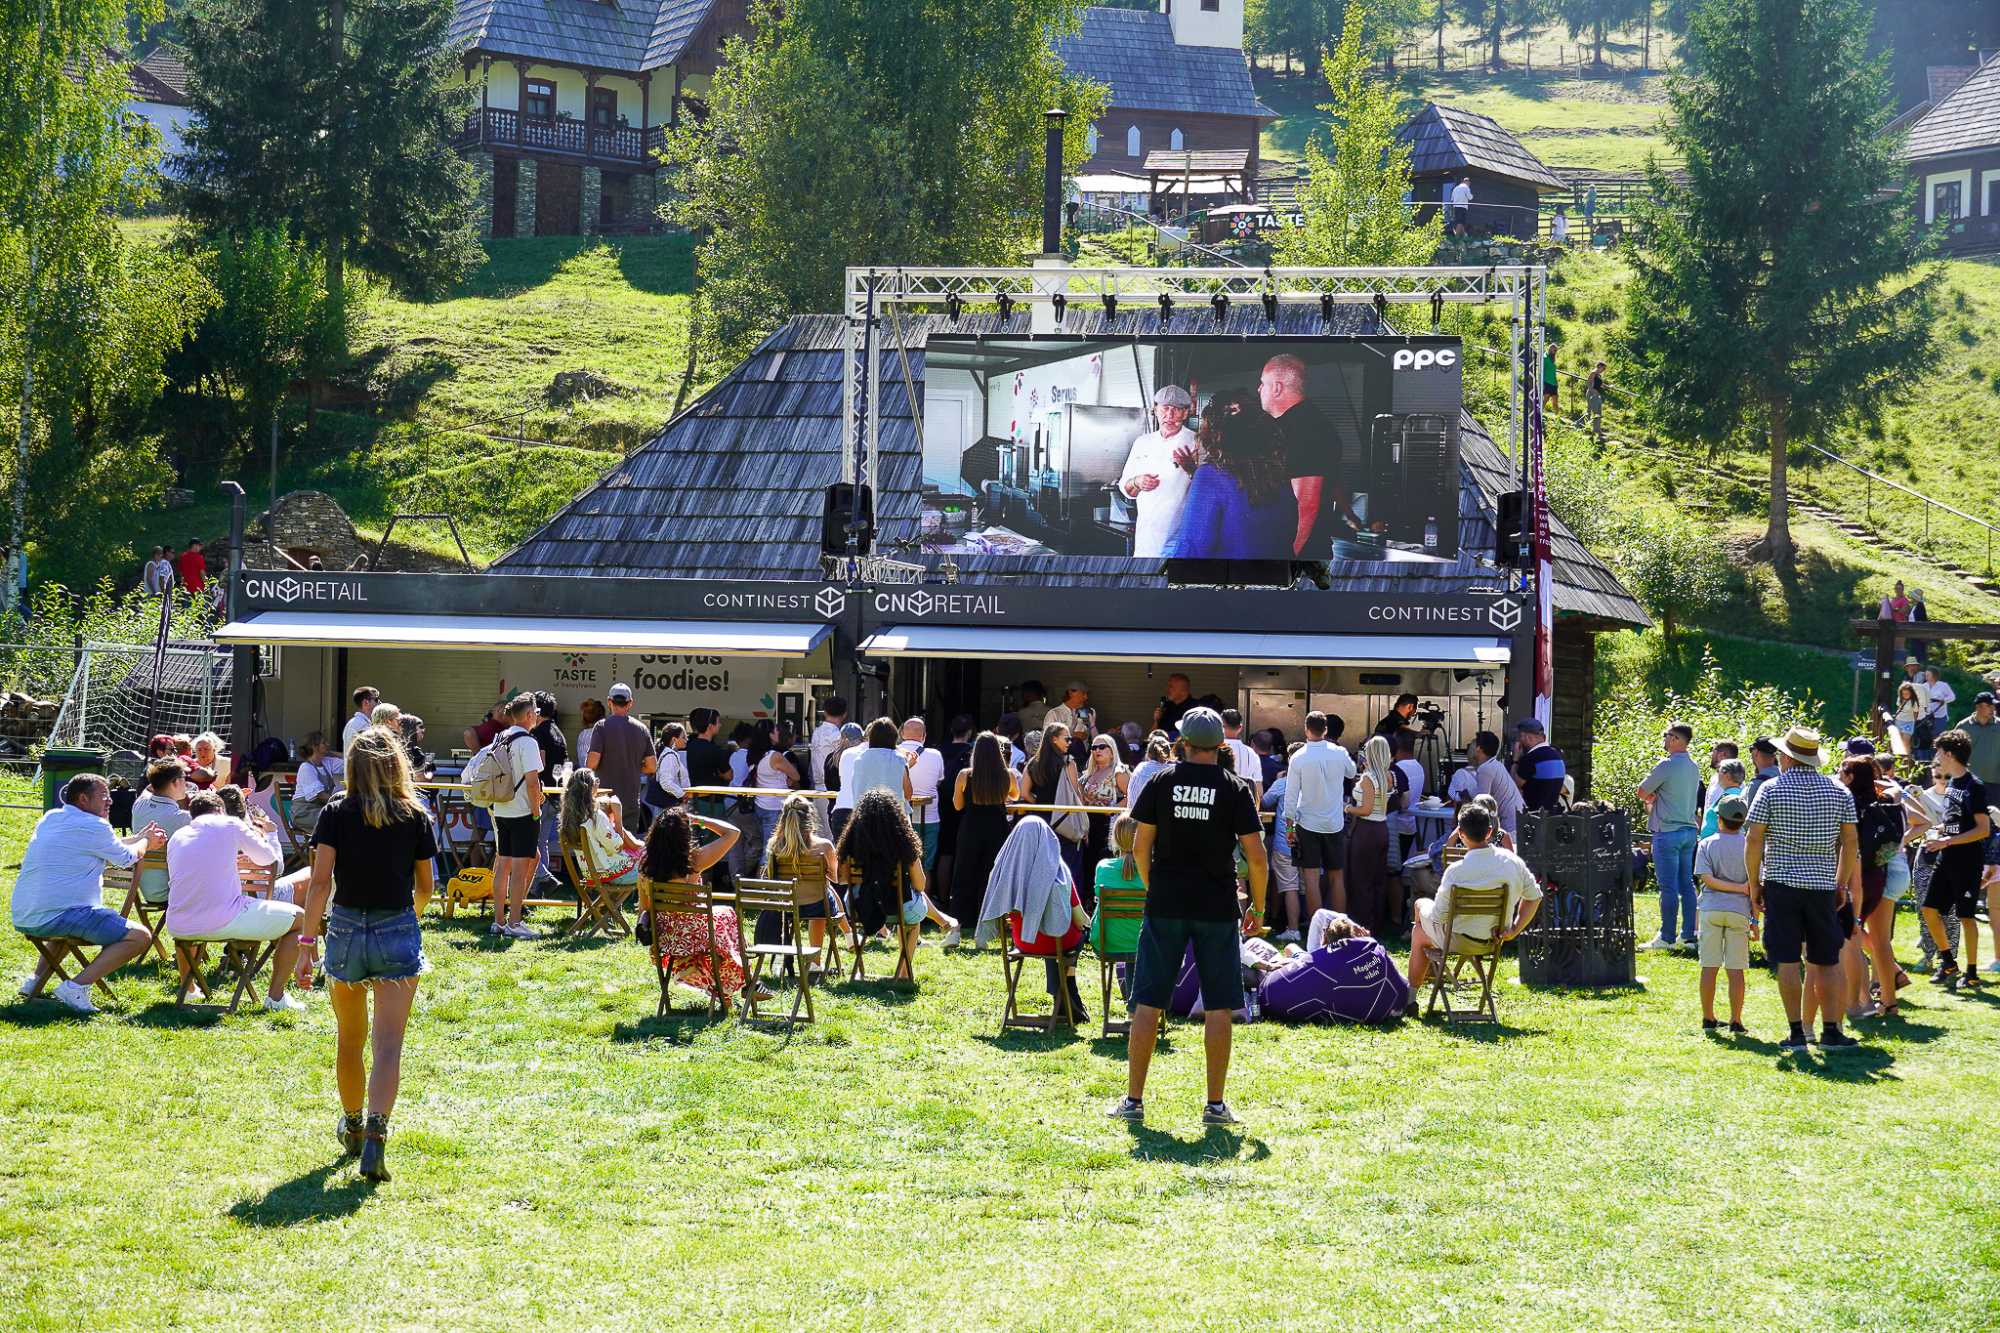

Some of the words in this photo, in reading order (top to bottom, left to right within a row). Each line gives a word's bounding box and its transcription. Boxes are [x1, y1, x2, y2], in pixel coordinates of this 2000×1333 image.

[1255, 214, 1305, 228] TASTE
[1393, 349, 1456, 370] ppc
[245, 579, 275, 599] CN
[302, 581, 368, 601] RETAIL
[703, 593, 811, 609] CONTINEST
[874, 593, 905, 612] CN
[935, 594, 1006, 614] RETAIL
[1368, 606, 1485, 621] CONTINEST
[553, 669, 597, 682] TASTE
[633, 667, 730, 692] foodies!
[1172, 785, 1217, 806] SZABI
[1174, 805, 1210, 821] SOUND
[1353, 956, 1381, 975] Magically
